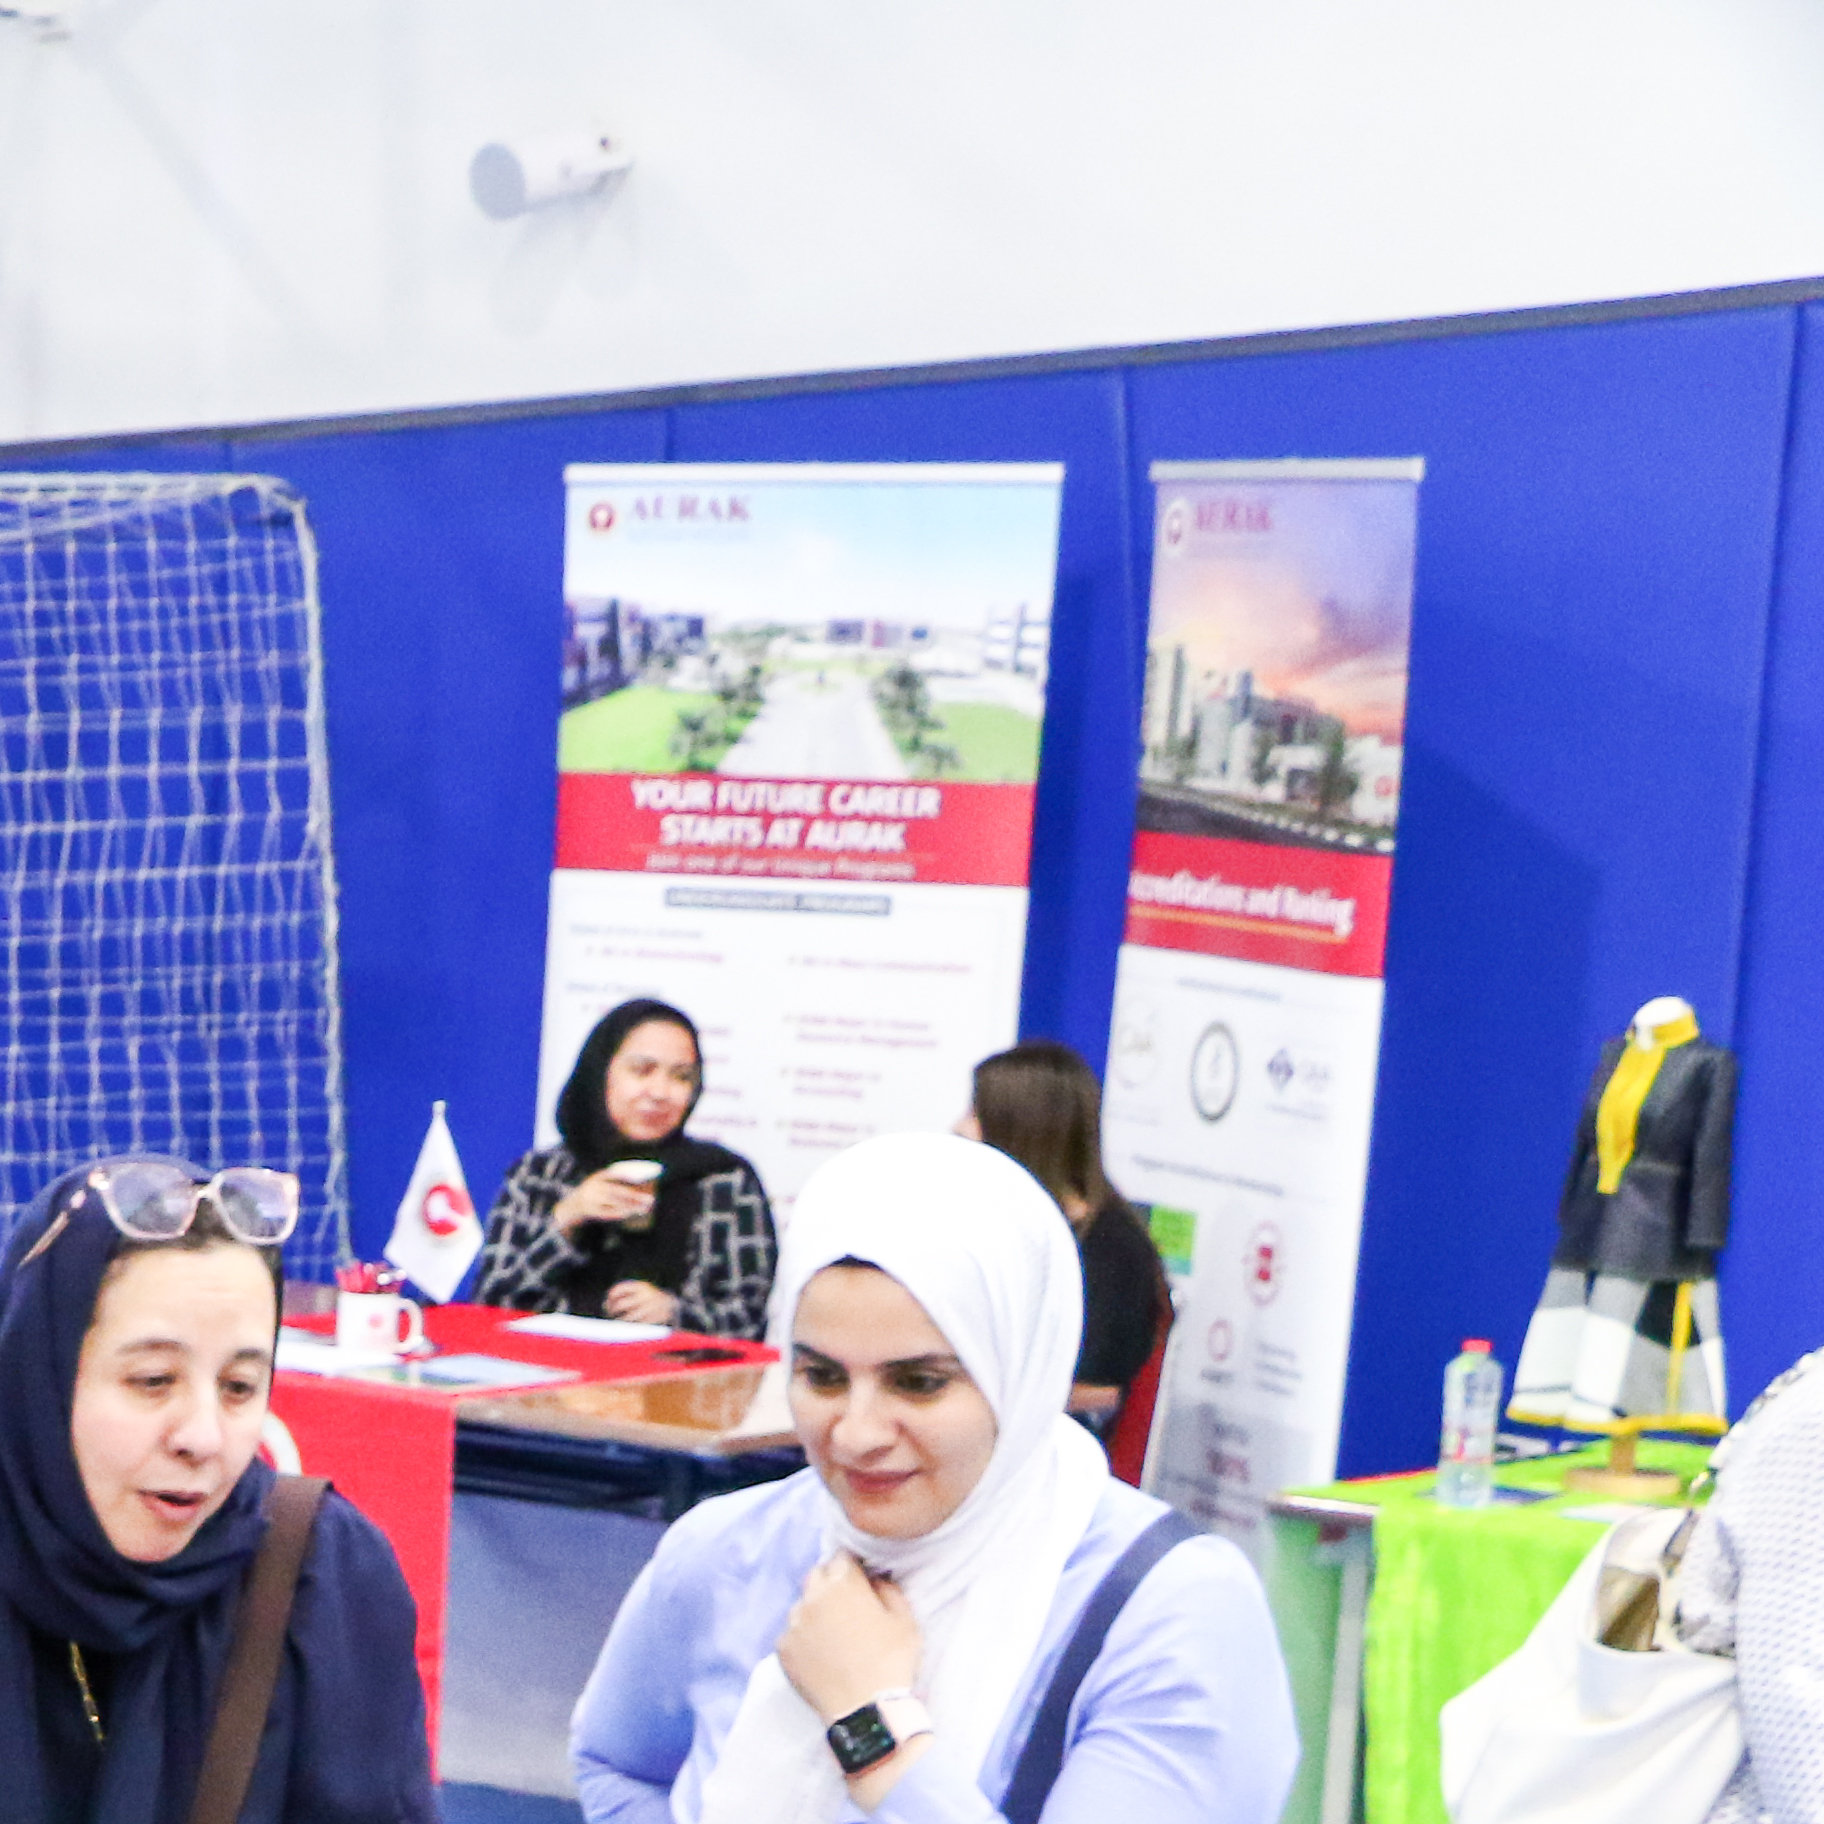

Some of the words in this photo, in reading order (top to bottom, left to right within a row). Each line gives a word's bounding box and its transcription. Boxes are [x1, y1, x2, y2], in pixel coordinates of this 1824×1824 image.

[631, 778, 714, 811] YOUR
[716, 780, 826, 815] FUTURE
[828, 784, 942, 820] CAREER
[660, 813, 764, 849] STARTS
[765, 816, 803, 850] AT
[804, 819, 908, 853] AURAK
